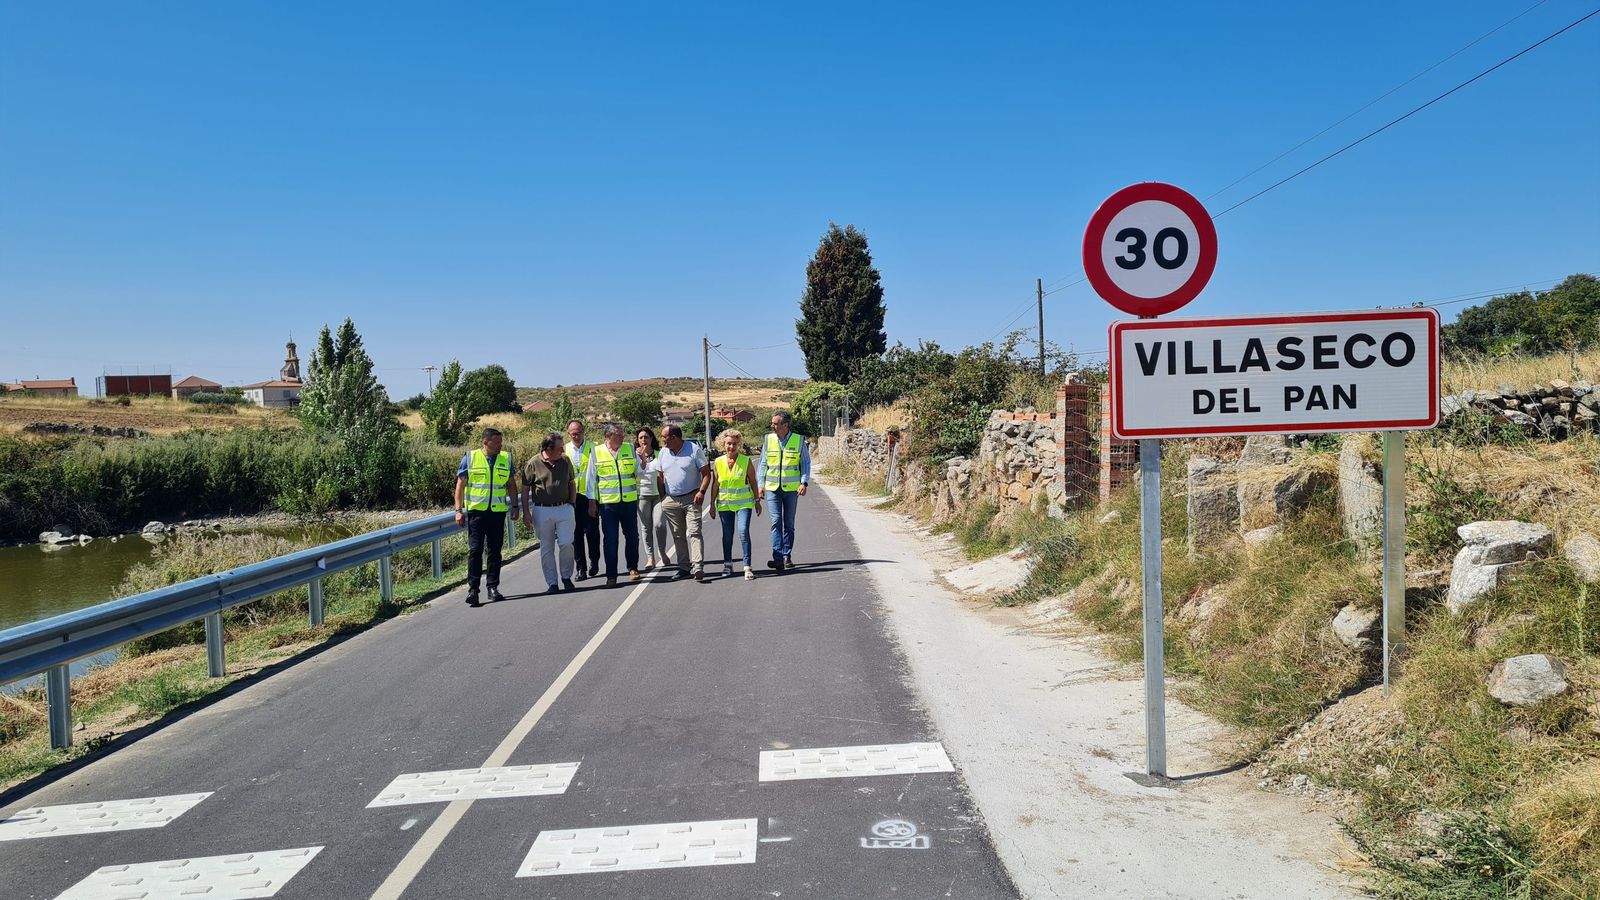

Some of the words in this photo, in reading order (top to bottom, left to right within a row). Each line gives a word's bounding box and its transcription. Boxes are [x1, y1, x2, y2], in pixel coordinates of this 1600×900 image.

[1114, 226, 1189, 270] 30
[1135, 331, 1416, 377] VILLASECO
[1193, 387, 1260, 415] DEL
[1284, 383, 1357, 412] PAN
